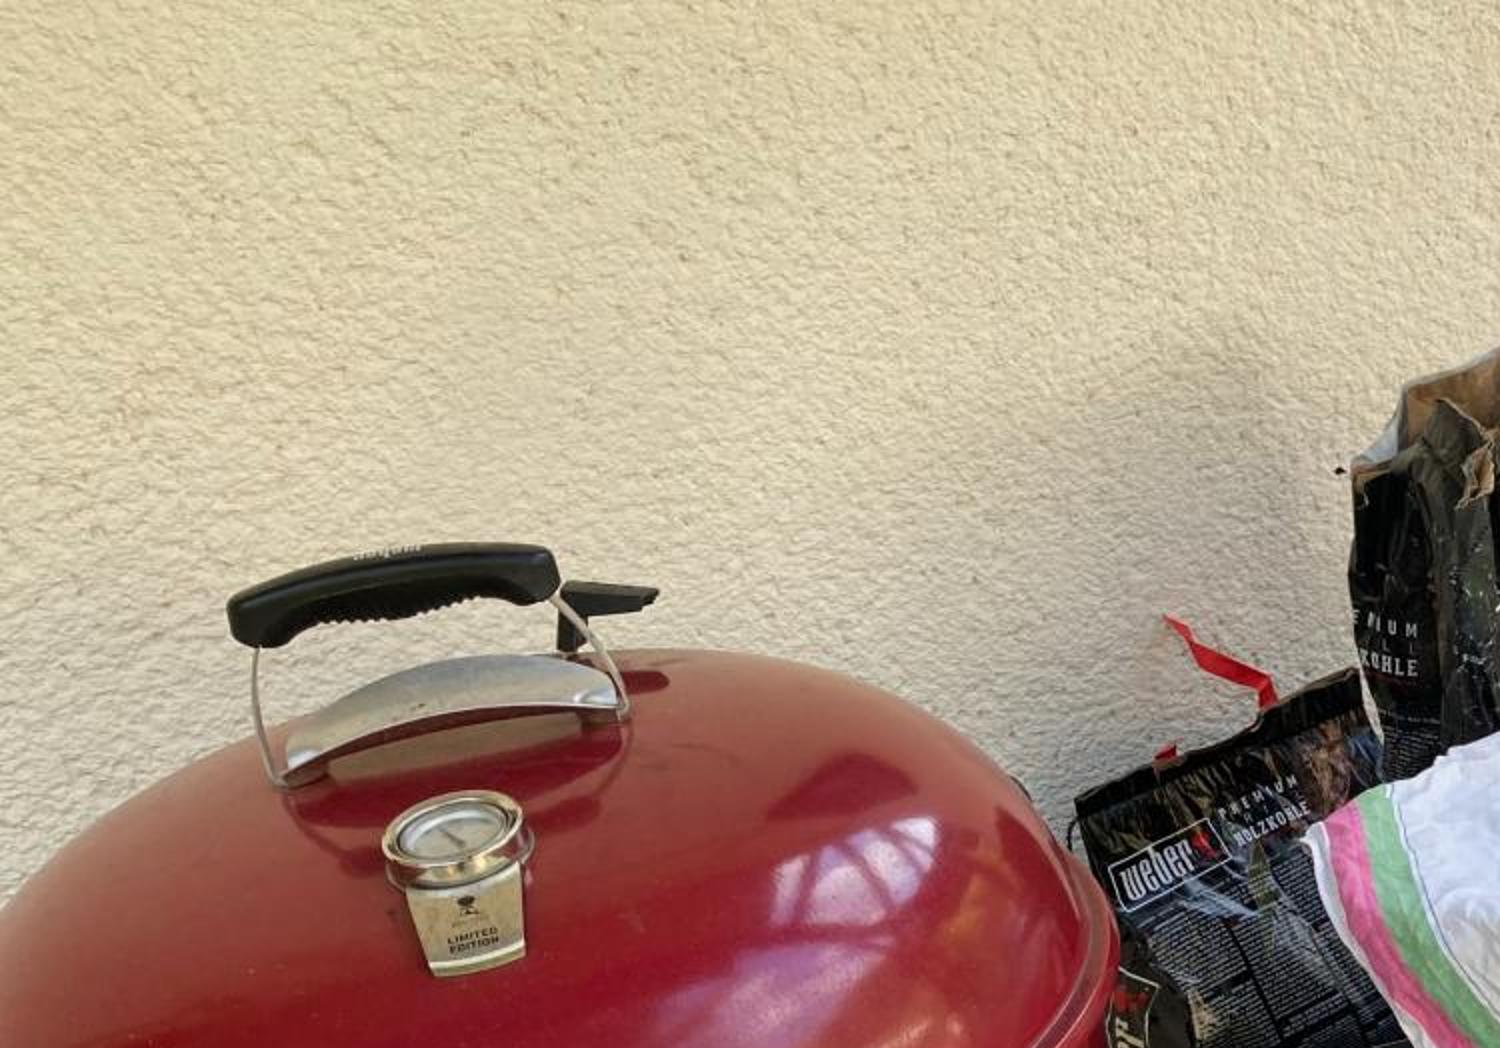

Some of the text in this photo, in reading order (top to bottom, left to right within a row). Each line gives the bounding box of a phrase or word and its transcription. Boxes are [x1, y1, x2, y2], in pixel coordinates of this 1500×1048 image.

[1218, 774, 1298, 820] PREMIUM
[1233, 801, 1311, 848] HOLZKOHLE
[1119, 838, 1195, 901] weber
[448, 927, 498, 945] LIMITED
[450, 936, 499, 955] EDITION
